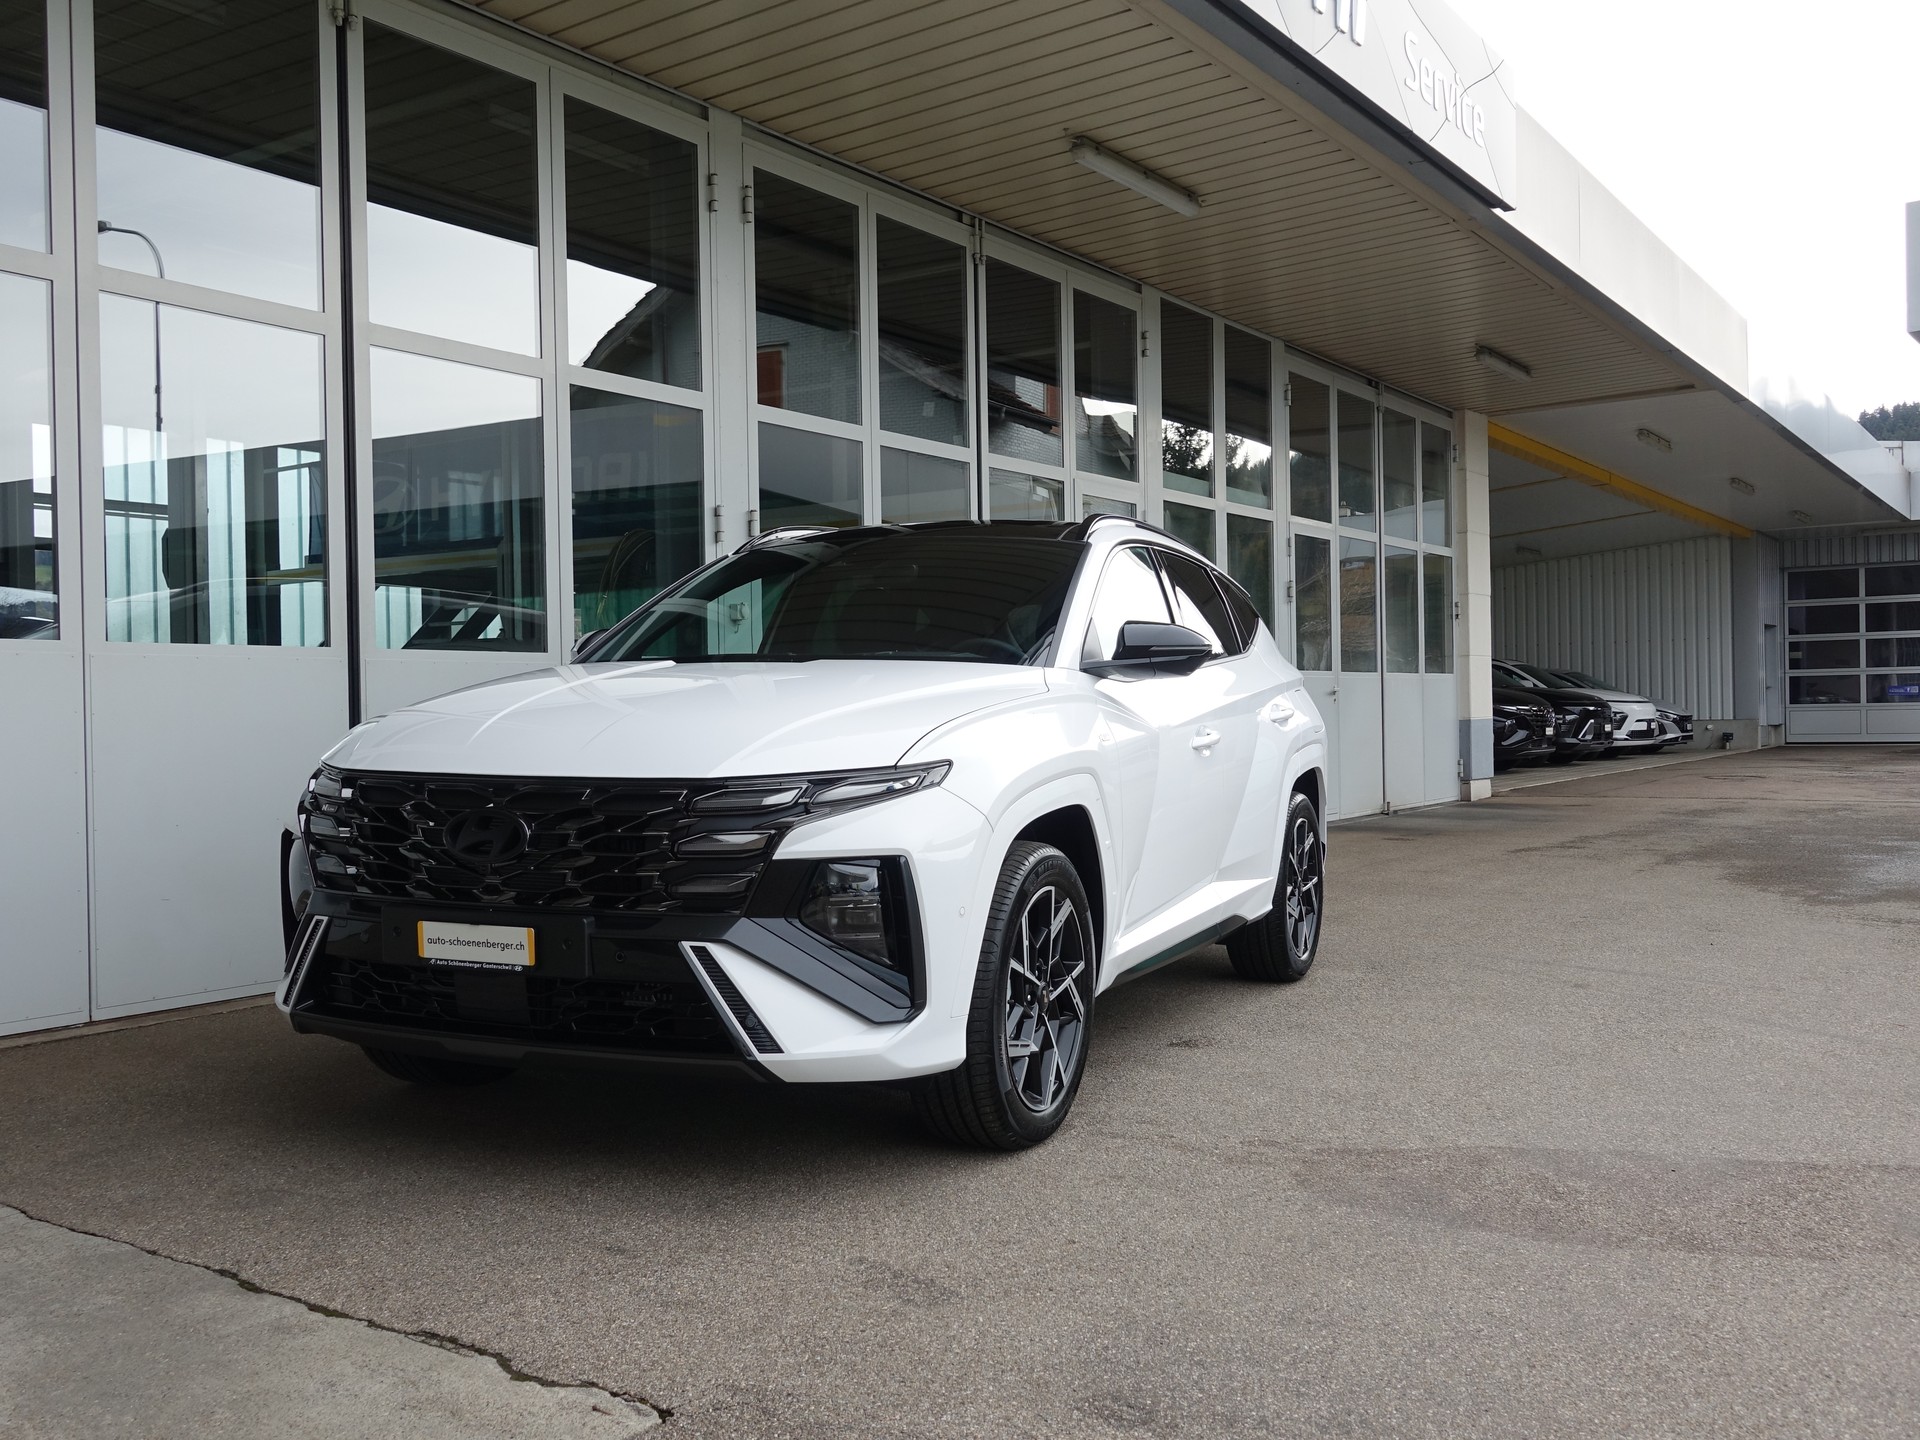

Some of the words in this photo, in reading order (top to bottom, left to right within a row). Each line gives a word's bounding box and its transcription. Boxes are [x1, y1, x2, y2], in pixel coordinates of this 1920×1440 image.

[1403, 30, 1485, 148] Service
[427, 936, 525, 951] auto-schoenenberger.ch
[448, 960, 482, 969] Schönenberger
